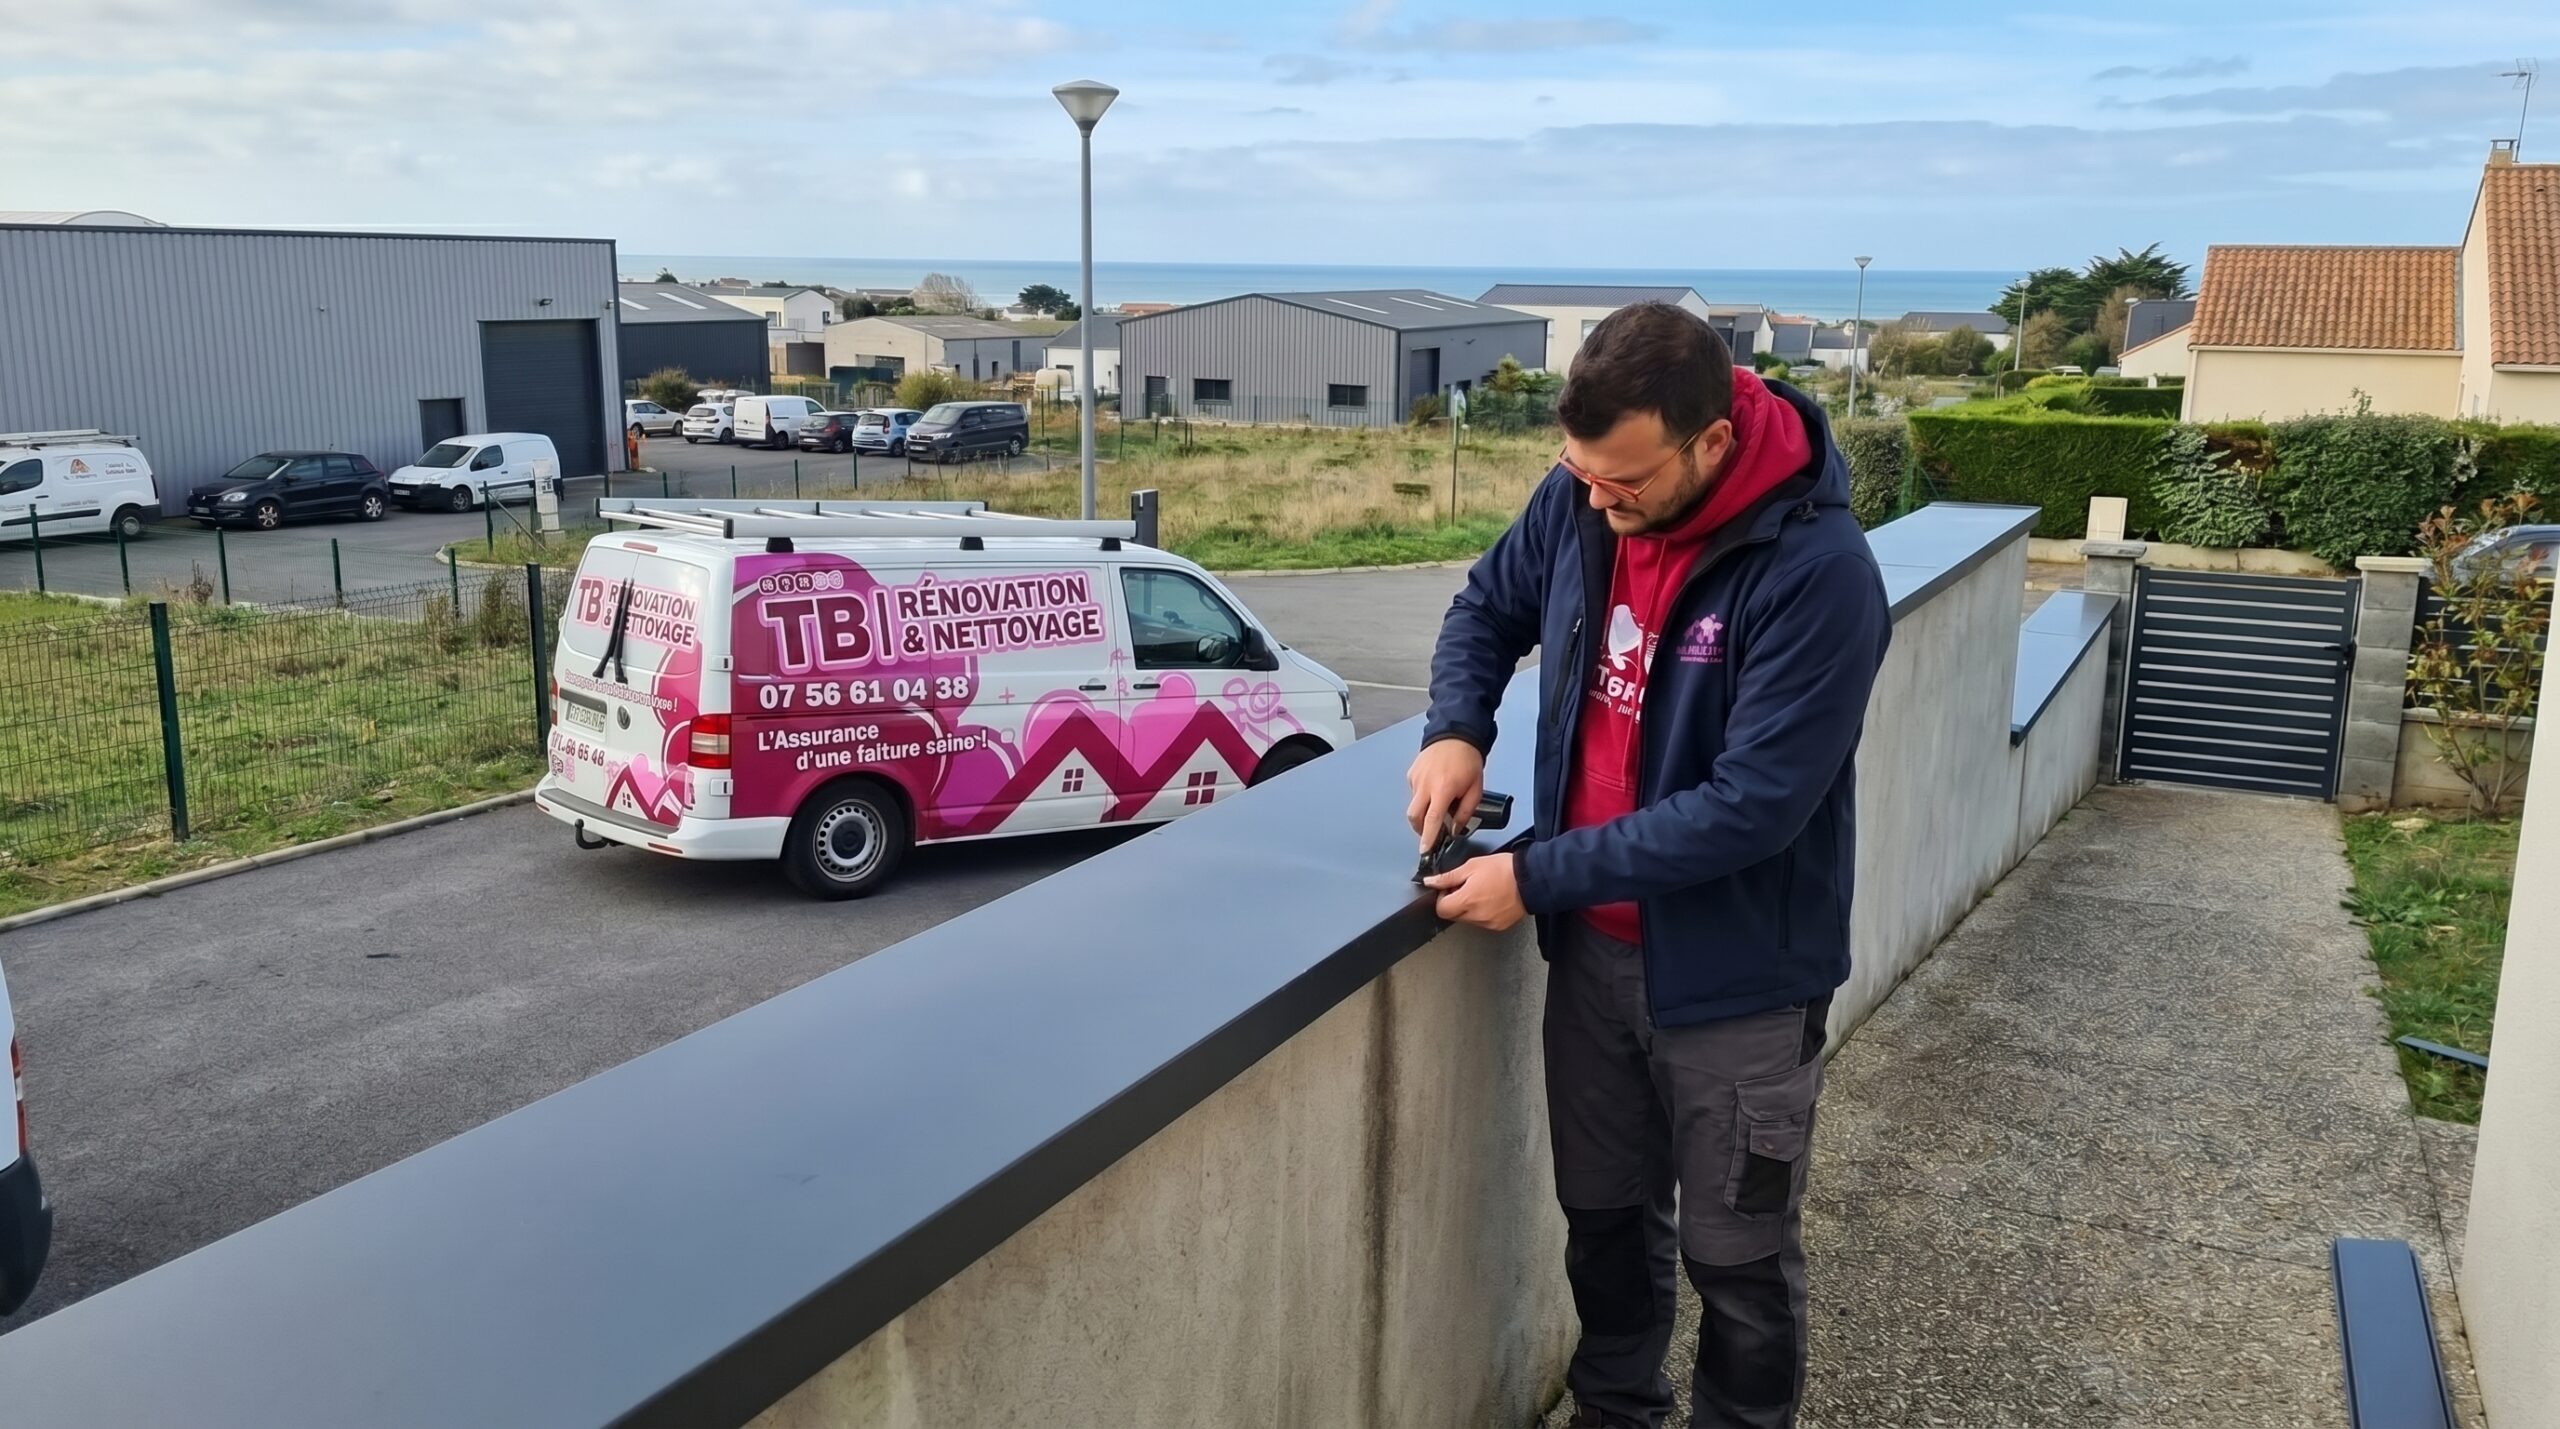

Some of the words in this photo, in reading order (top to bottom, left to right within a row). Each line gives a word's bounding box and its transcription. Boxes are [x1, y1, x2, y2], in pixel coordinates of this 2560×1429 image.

[577, 578, 604, 623] TB
[897, 577, 1088, 619] RÉNOVATION
[765, 596, 871, 668] TB
[903, 625, 926, 653] &
[932, 609, 1100, 651] NETTOYAGE
[759, 684, 796, 710] 07
[805, 682, 842, 707] 56
[850, 680, 885, 704] 61
[893, 678, 928, 702] 04
[935, 676, 970, 700] 38
[758, 724, 880, 751] L'Assurance
[796, 749, 852, 771] d'une
